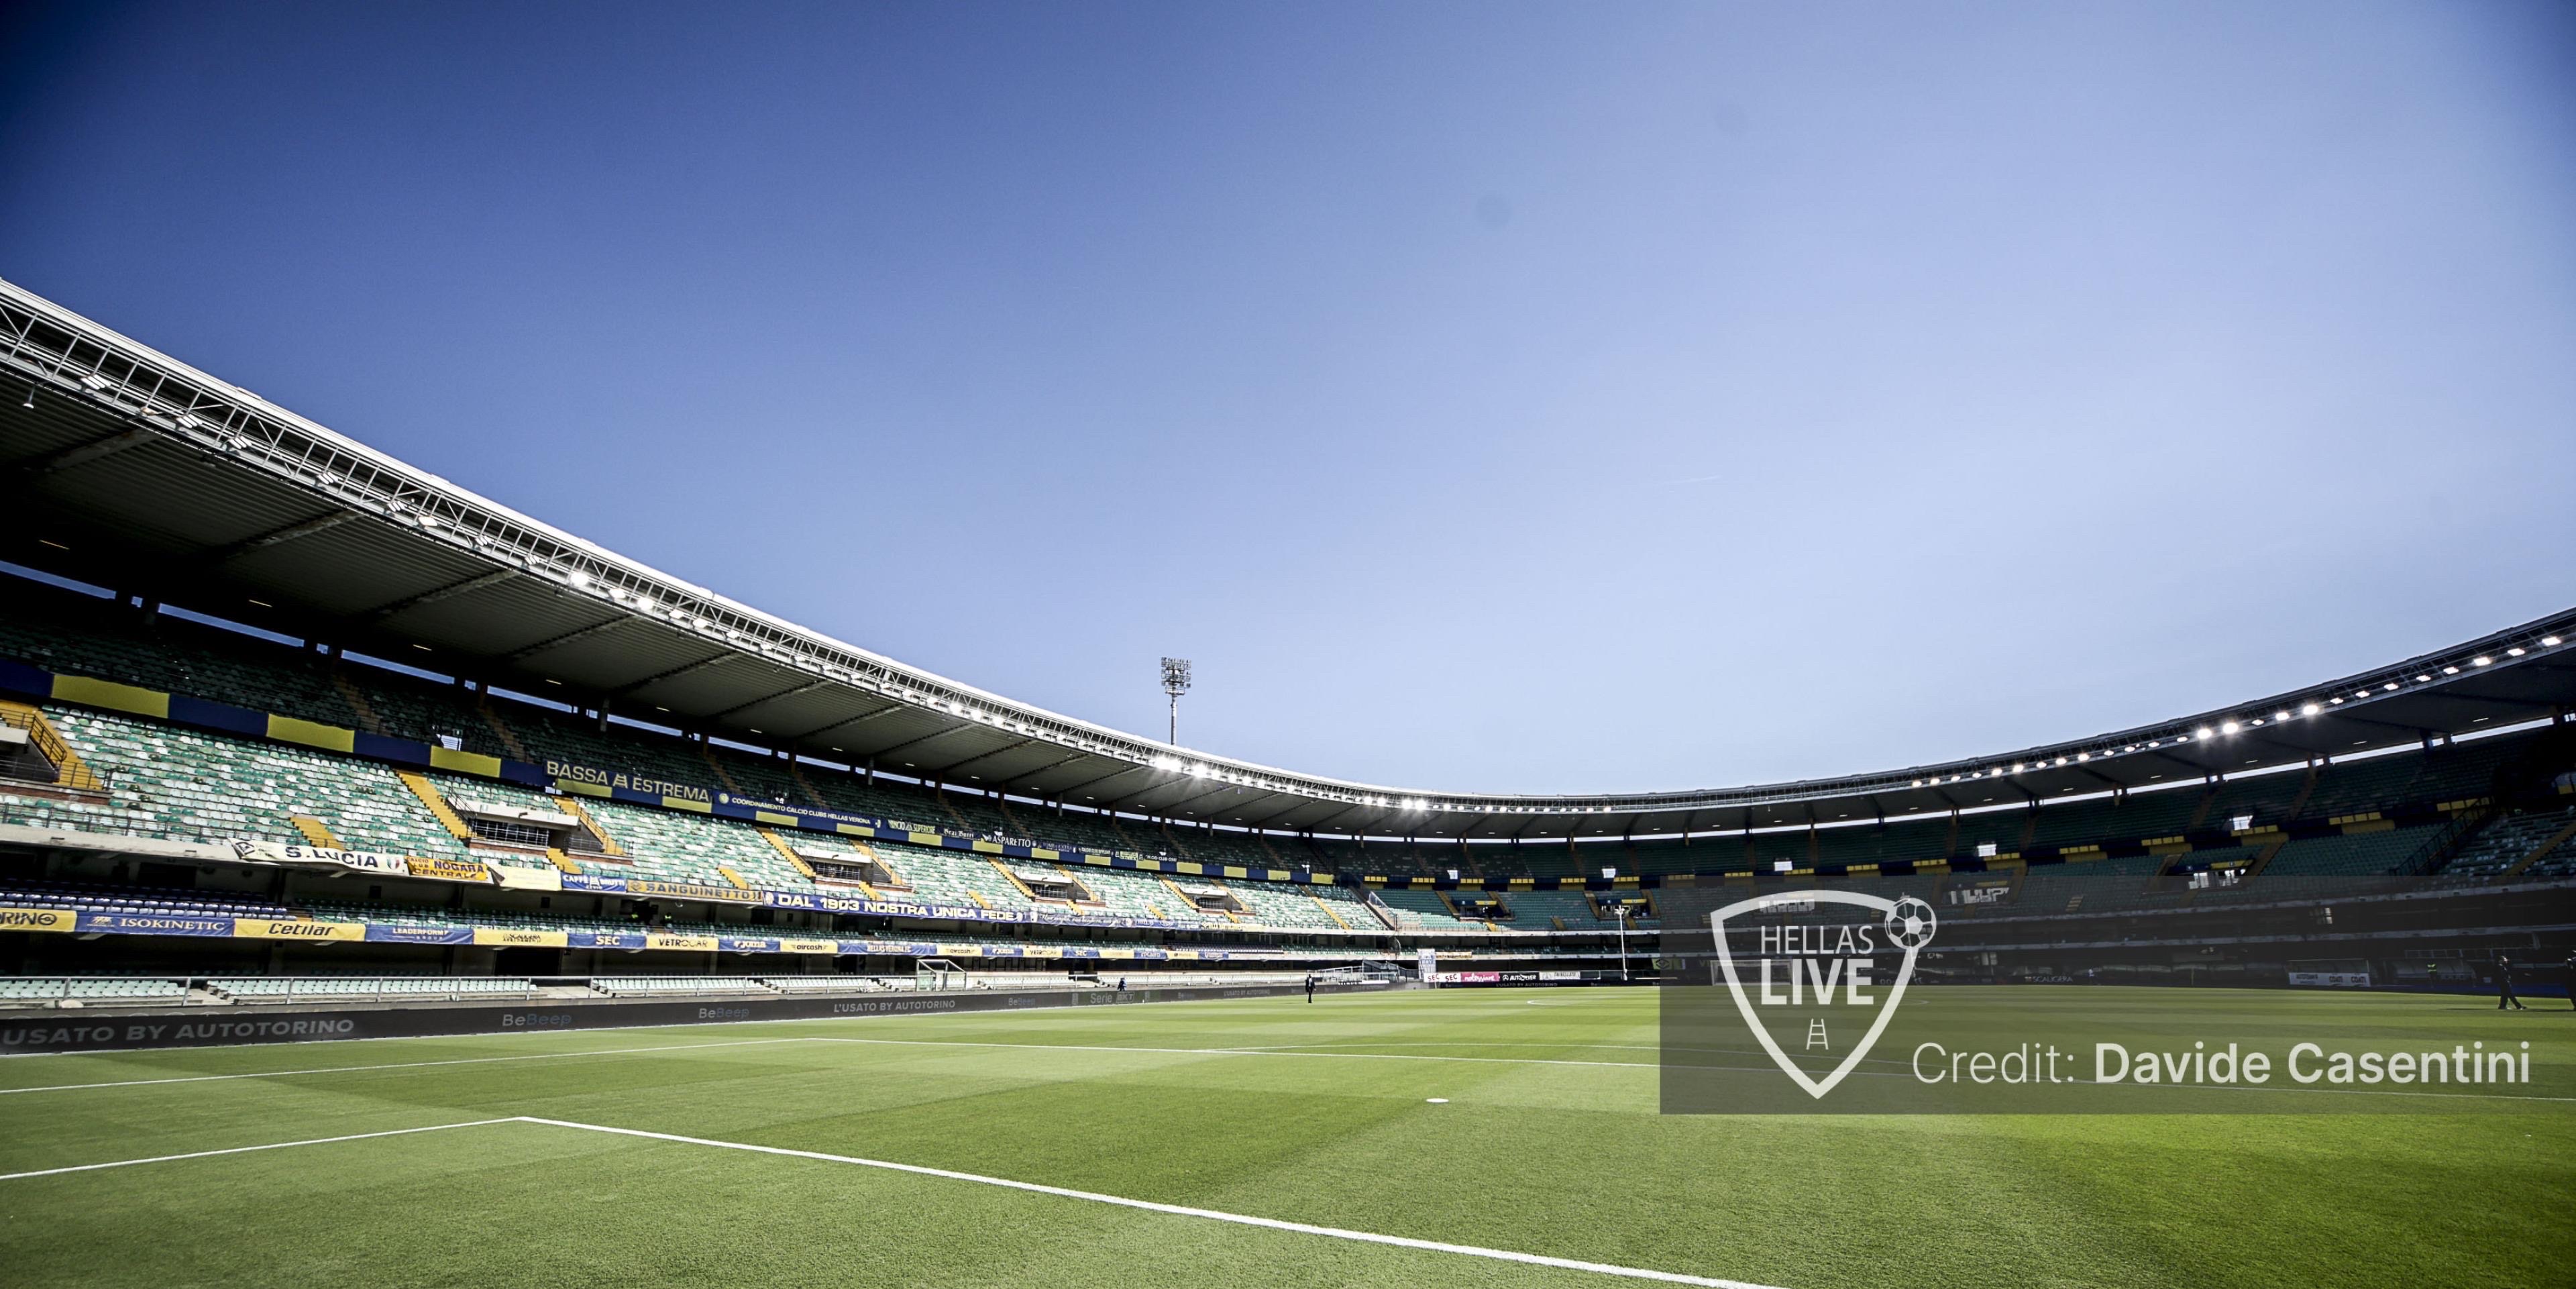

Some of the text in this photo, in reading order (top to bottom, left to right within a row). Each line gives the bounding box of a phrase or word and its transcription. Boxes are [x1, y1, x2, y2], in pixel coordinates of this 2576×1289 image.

[547, 760, 710, 802] BASSA ESTREMA
[732, 797, 871, 825] COORDINAMENTO CALCIO CLUBS HELLAS VERONA
[992, 835, 1031, 847] ASPARETTO
[433, 860, 484, 873] NOGARA
[645, 882, 751, 900] SANGUINETTO
[778, 895, 1016, 921] DAL 1903 NOSTRA UNICA FEDE
[0, 912, 58, 926] RINO
[120, 917, 226, 931] ISOKINETIC
[268, 923, 335, 937] Cetilar
[596, 936, 620, 945] SEC
[659, 938, 708, 947] VETROCAR
[1090, 993, 1112, 1004] Serie
[698, 1007, 750, 1020] BeBeep
[834, 1000, 956, 1013] L'USATO BY AUTOTORINO
[502, 1013, 572, 1029] BeBeep
[2, 1019, 355, 1045] USATO BY AUTOTORINO
